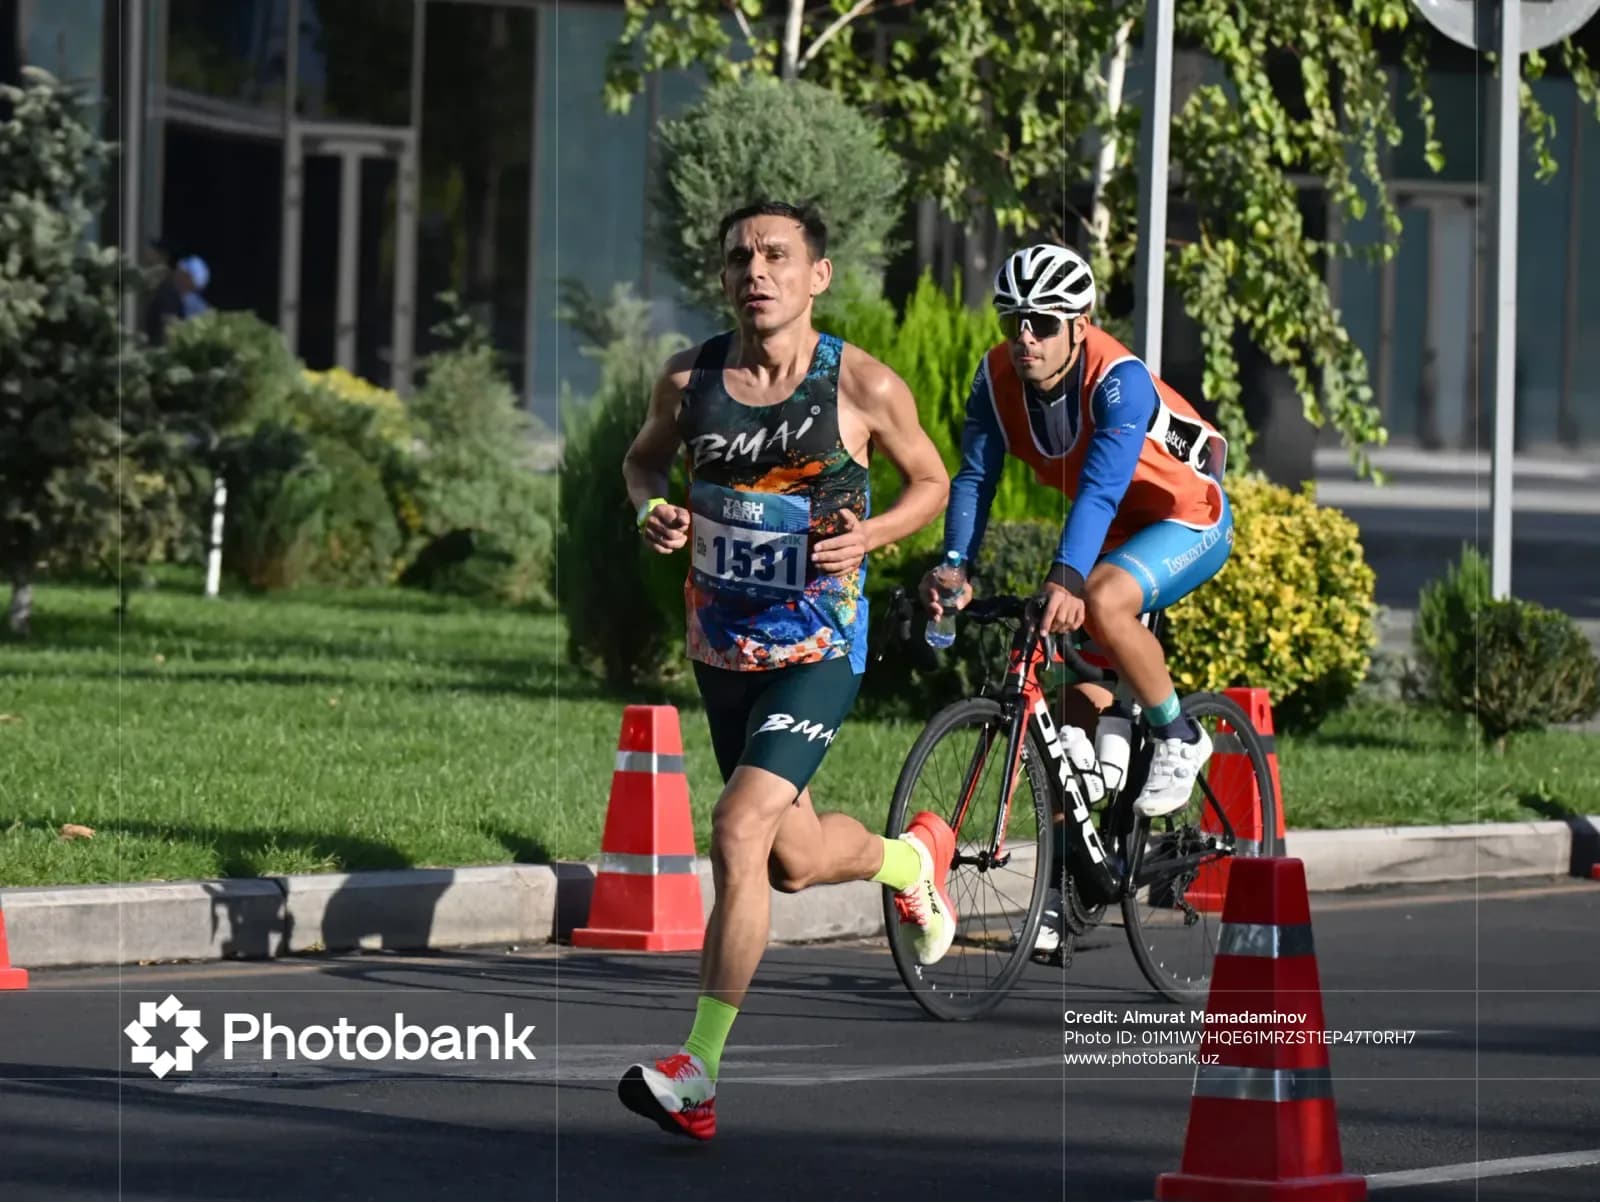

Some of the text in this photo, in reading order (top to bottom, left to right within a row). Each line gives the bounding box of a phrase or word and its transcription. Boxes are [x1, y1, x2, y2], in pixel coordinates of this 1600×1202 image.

[689, 416, 814, 468] BMAI
[722, 505, 761, 521] KENT
[723, 497, 765, 515] TASH
[712, 535, 798, 586] 1531
[1034, 698, 1108, 865] DRAG
